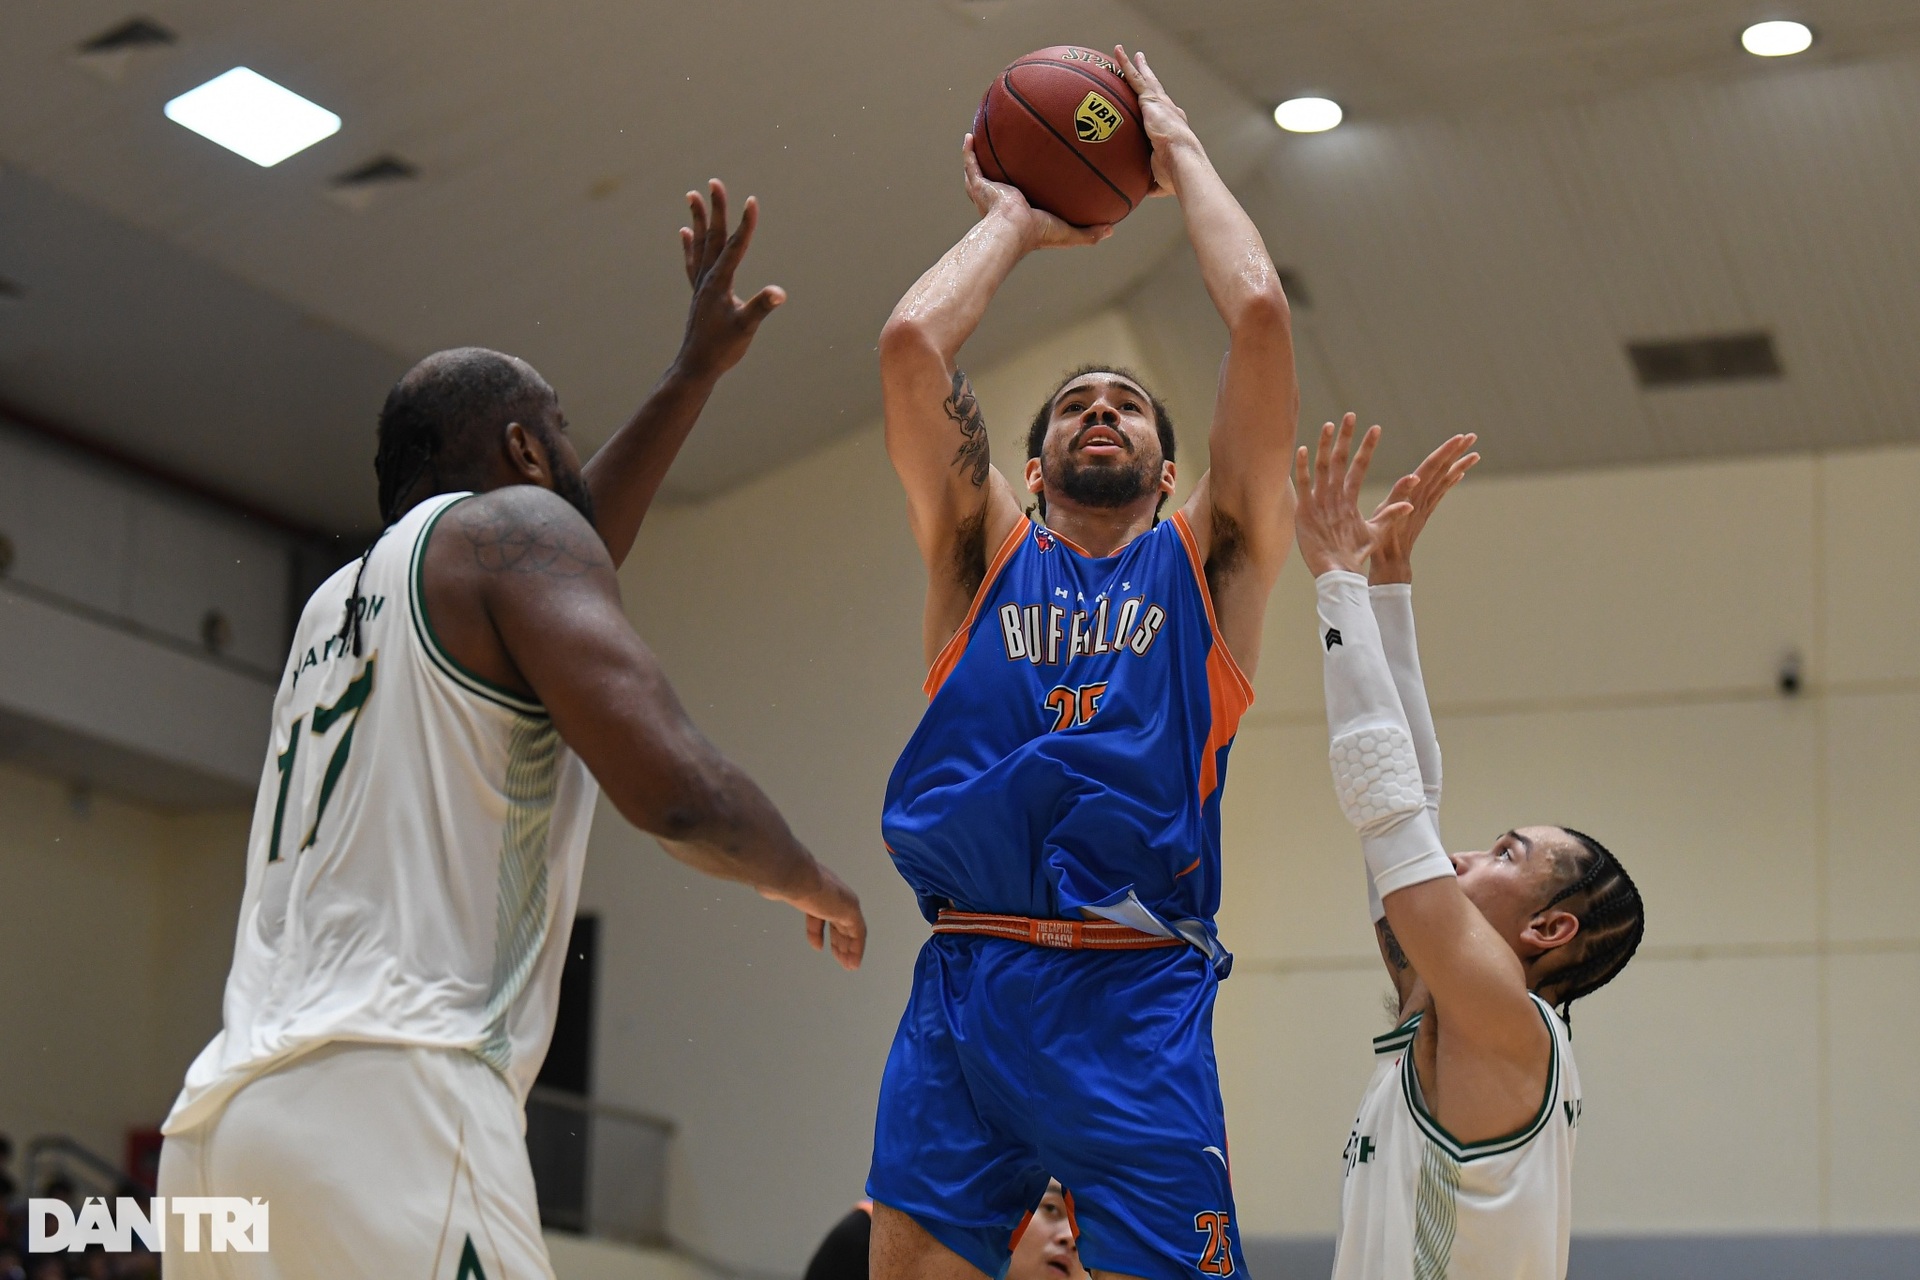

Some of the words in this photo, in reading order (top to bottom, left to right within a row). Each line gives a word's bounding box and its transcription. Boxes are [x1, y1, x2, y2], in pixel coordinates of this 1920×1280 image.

[1088, 100, 1117, 128] VBA
[268, 648, 378, 864] 17
[1036, 932, 1073, 947] LEGACY
[1037, 922, 1048, 932] THE
[1048, 922, 1073, 934] CAPITAL
[1194, 1210, 1235, 1278] 25
